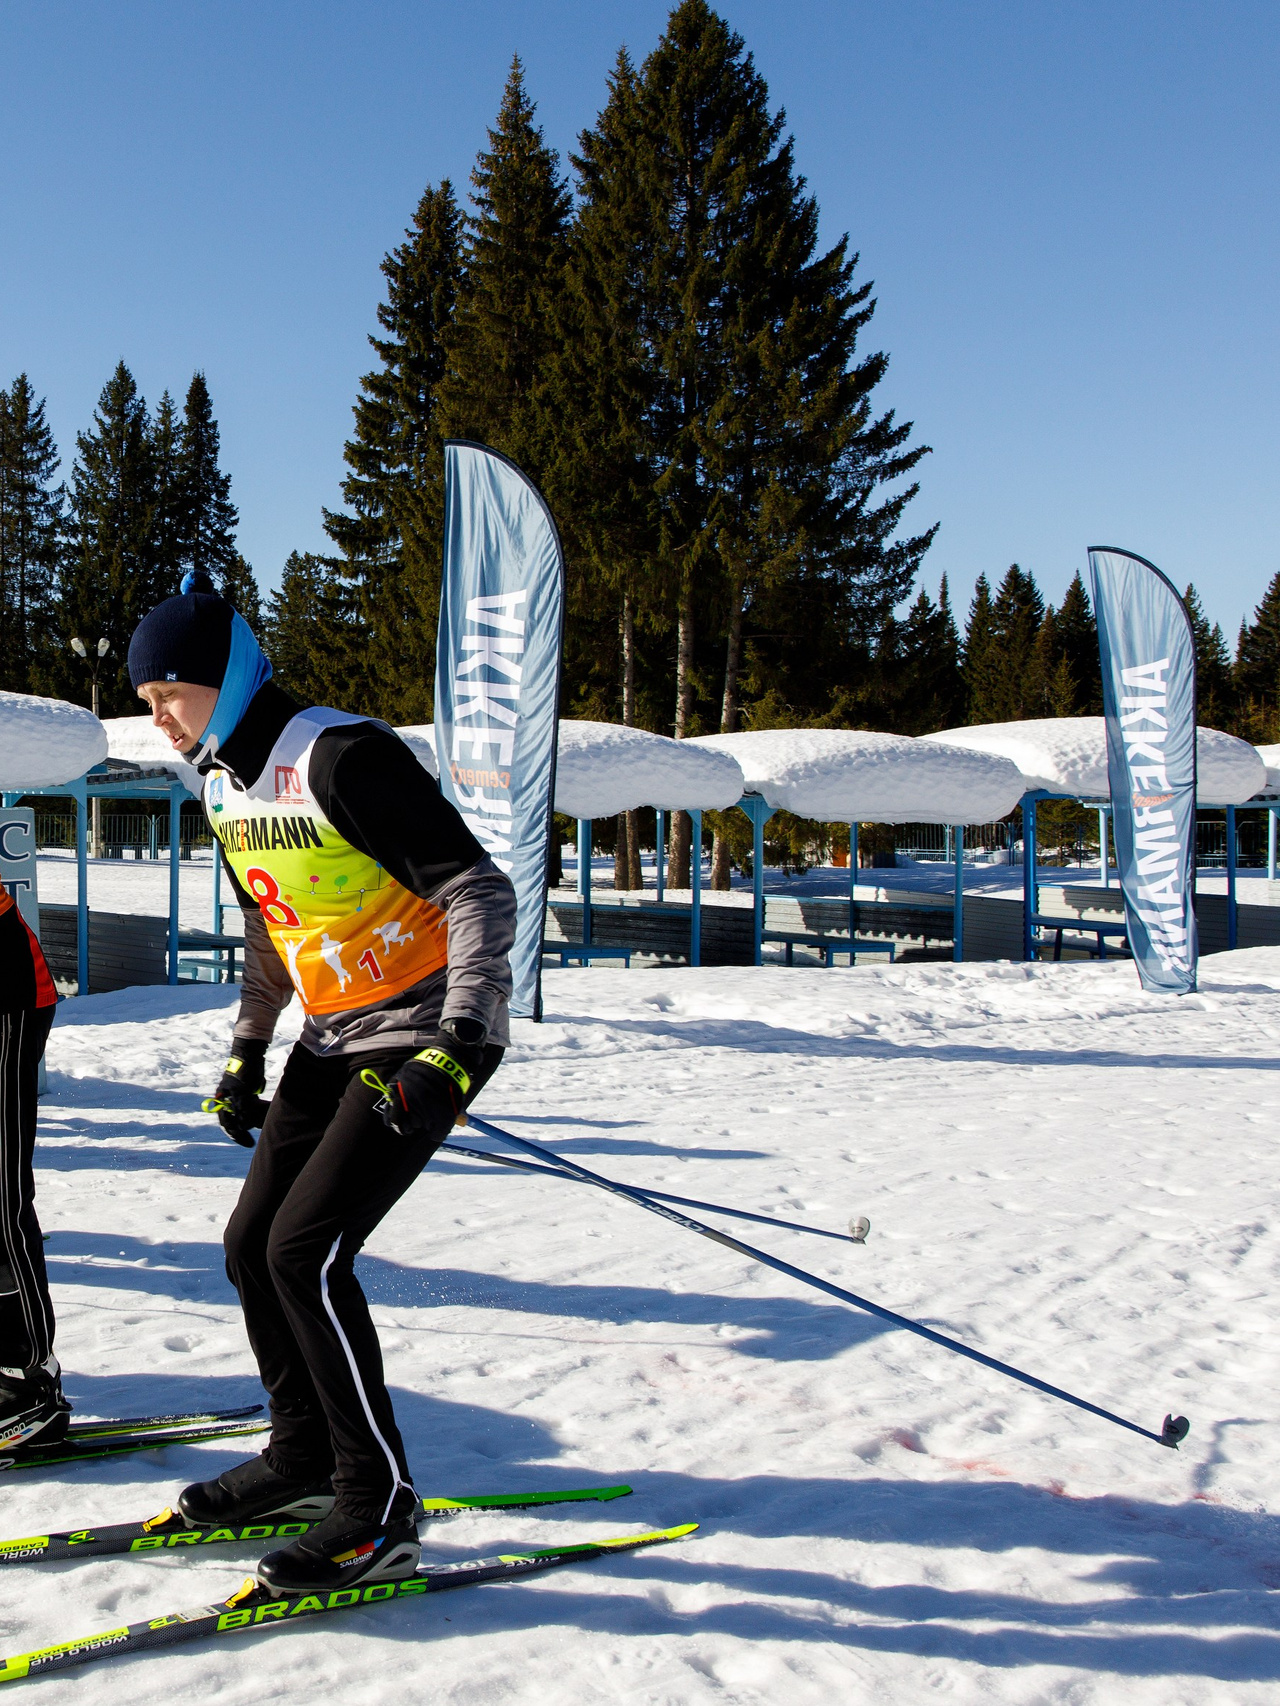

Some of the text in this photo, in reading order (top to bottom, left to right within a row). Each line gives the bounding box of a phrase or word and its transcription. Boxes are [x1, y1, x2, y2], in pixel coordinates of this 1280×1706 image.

[246, 866, 302, 929] 8
[357, 948, 384, 982] 1
[424, 1050, 466, 1082] HIDE
[129, 1521, 321, 1552] BRADO
[339, 1550, 374, 1569] SALOMON
[216, 1578, 429, 1631] BRADOS
[30, 1635, 128, 1667] WORLD CUP
